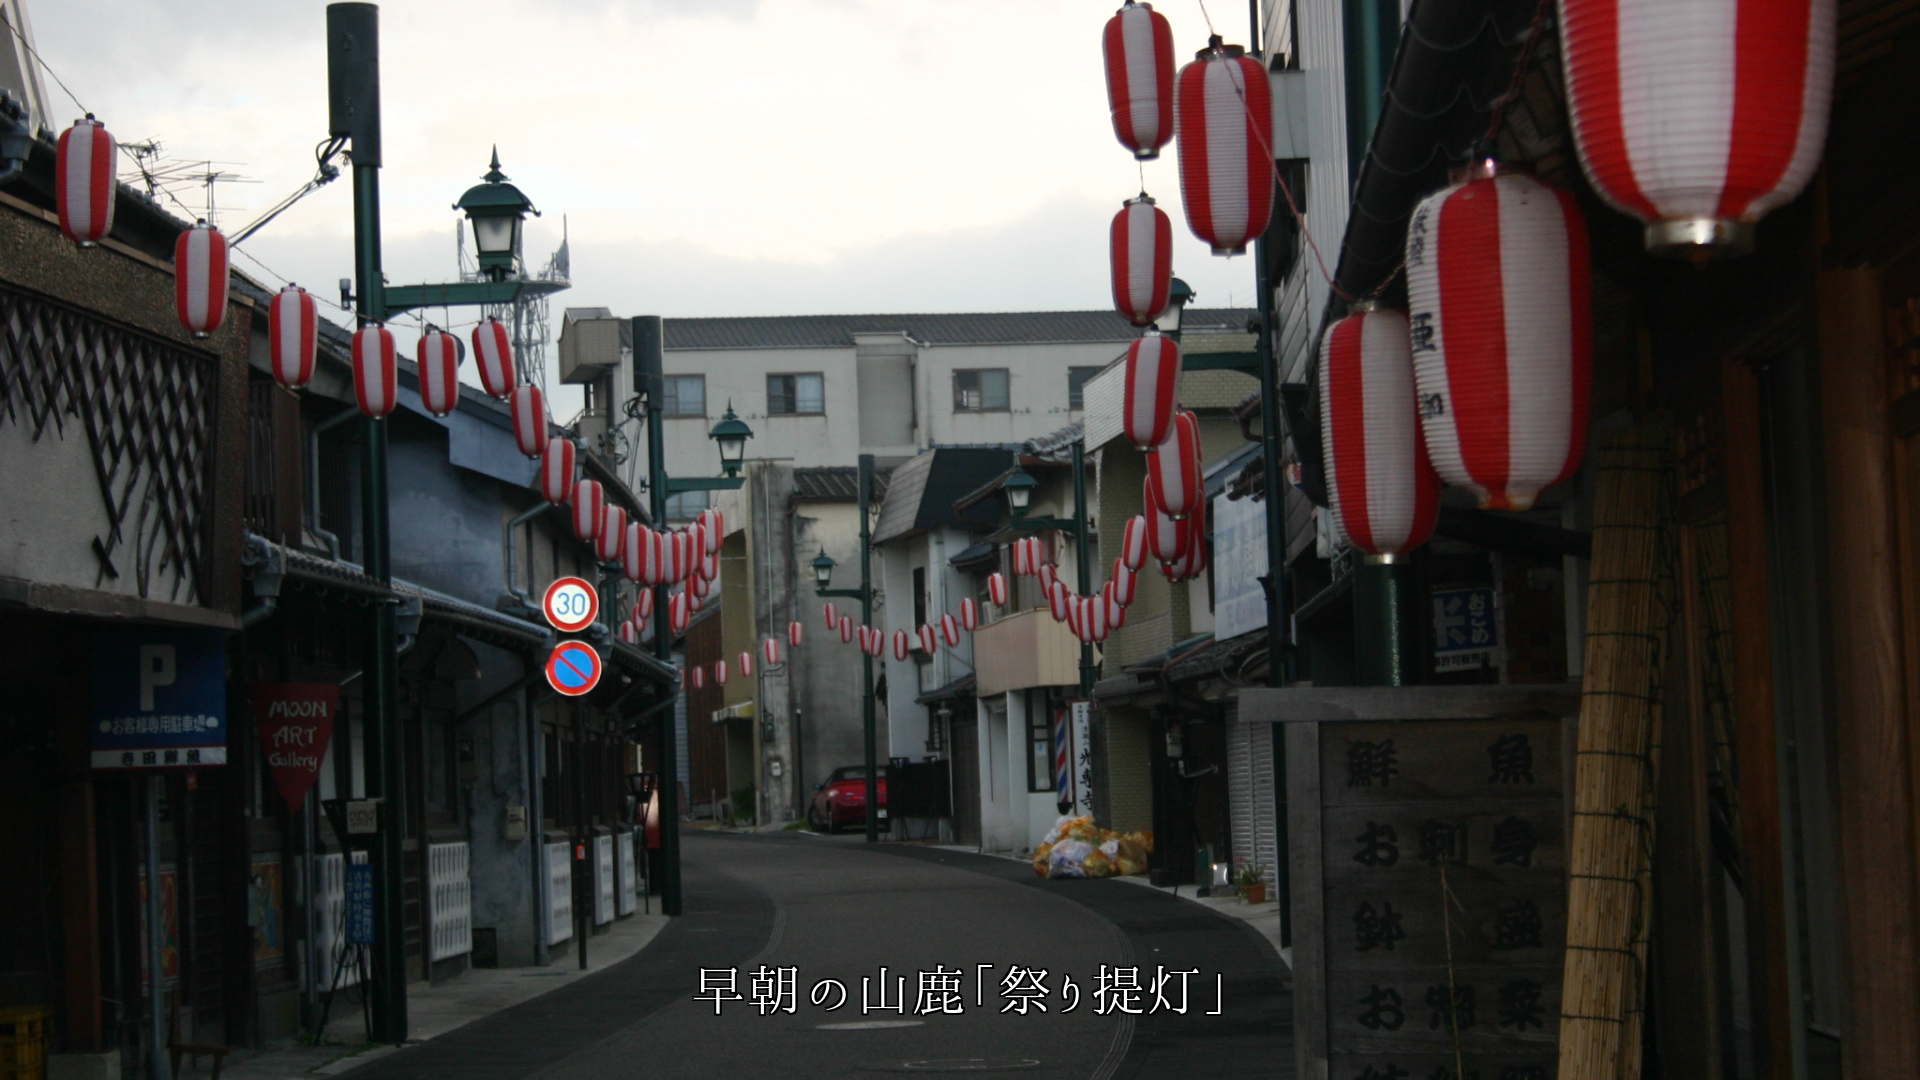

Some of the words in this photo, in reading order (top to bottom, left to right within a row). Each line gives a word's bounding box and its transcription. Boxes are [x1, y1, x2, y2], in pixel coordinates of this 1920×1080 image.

[556, 592, 586, 616] 30
[1468, 593, 1490, 644] おこめ
[140, 644, 177, 712] P
[267, 700, 328, 718] MOON
[111, 714, 207, 736] お客様専用駐車場
[271, 725, 318, 748] ART
[268, 751, 318, 773] Gallery
[1348, 734, 1535, 787] 鮮魚
[1354, 817, 1540, 868] お刺身
